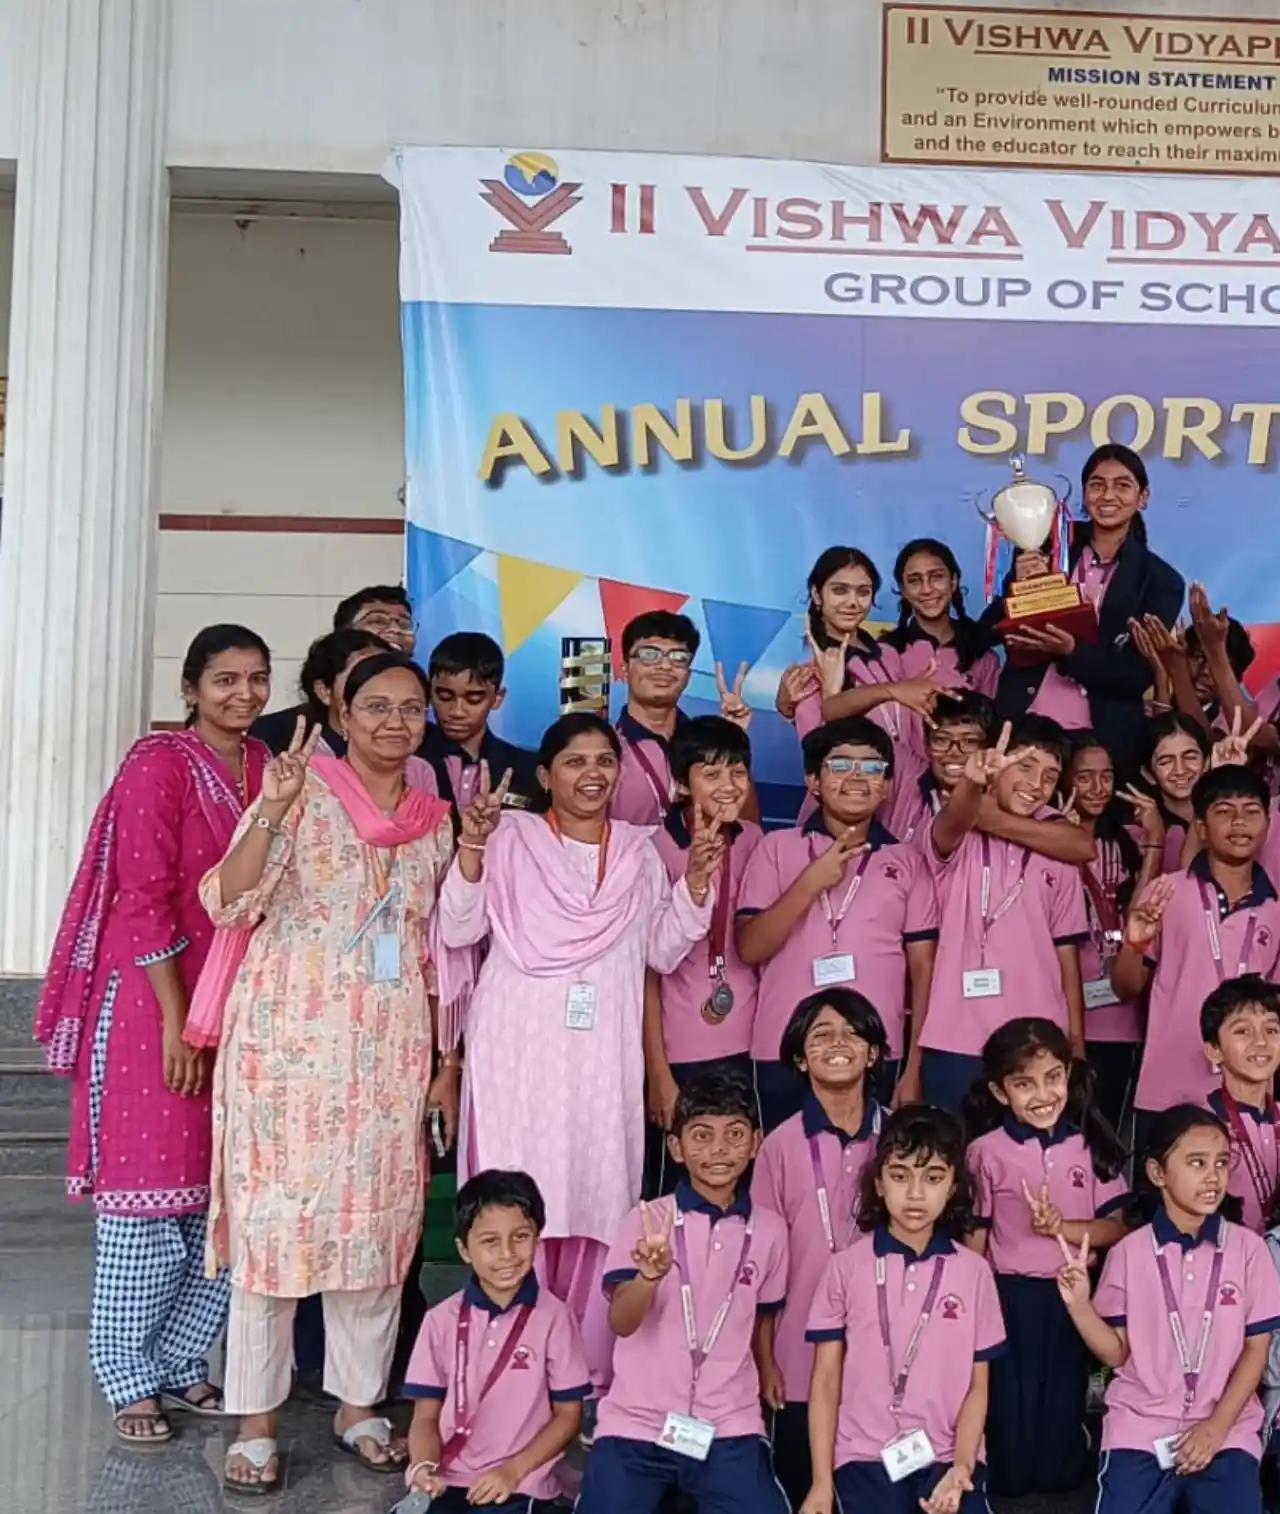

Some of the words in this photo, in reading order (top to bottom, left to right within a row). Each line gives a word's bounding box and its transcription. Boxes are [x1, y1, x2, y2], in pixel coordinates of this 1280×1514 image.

[944, 18, 1110, 52] VISHWA
[1048, 67, 1140, 85] MISSION
[1148, 72, 1276, 91] STATEMENT
[975, 88, 1048, 107] provide
[1054, 92, 1178, 111] well-rounded
[901, 111, 937, 126] and
[944, 114, 967, 127] an
[973, 112, 1096, 133] Environment
[1102, 118, 1158, 135] which
[1164, 123, 1262, 140] empowers
[914, 135, 949, 150] and
[956, 135, 986, 152] the
[992, 138, 1077, 155] educator
[1083, 141, 1101, 156] to
[1107, 143, 1160, 159] reach
[1166, 144, 1210, 160] their
[683, 185, 1019, 247] VISHWA
[824, 271, 1031, 308] GROUP
[1046, 279, 1124, 311] OF
[477, 391, 911, 480] ANNUAL
